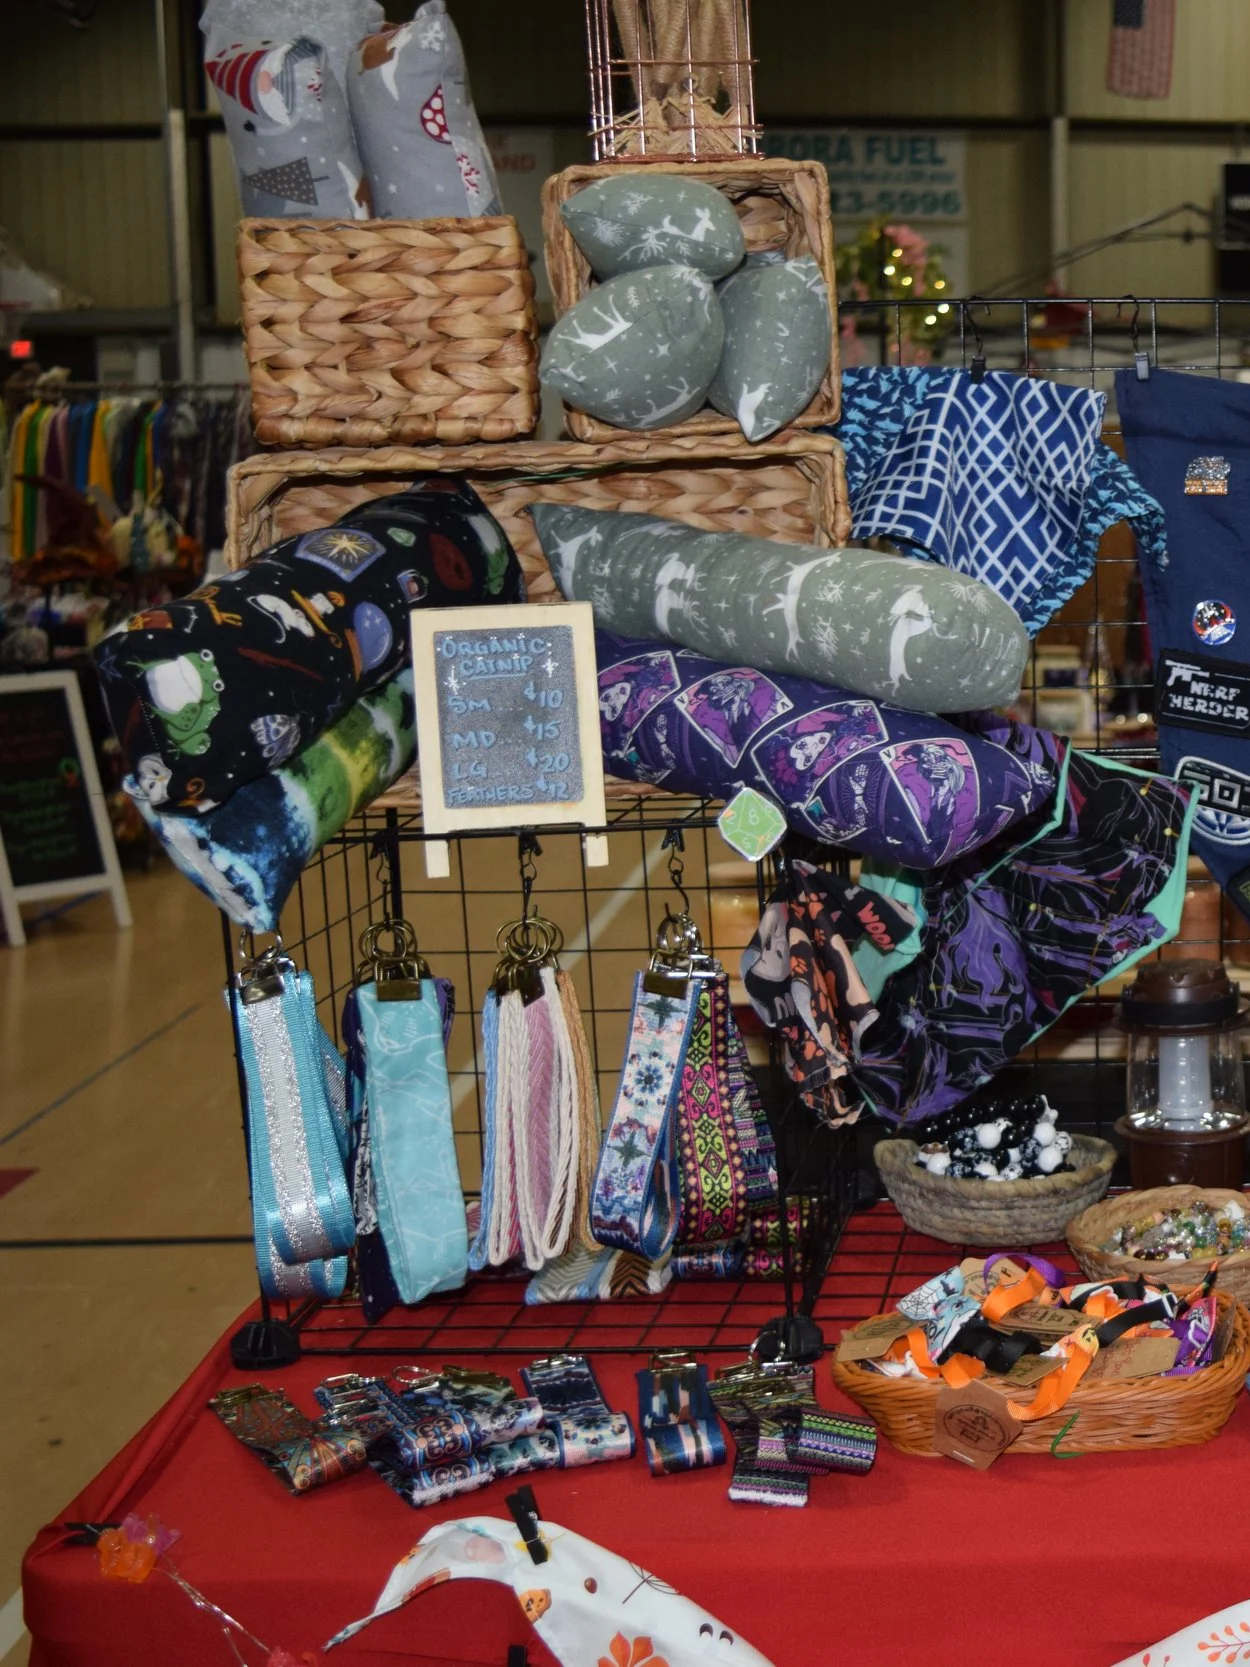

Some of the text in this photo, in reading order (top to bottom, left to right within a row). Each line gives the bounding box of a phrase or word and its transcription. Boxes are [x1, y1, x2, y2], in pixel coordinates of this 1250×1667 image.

[767, 134, 945, 165] RORA FUEL
[441, 637, 547, 658] ORGANIC
[459, 656, 533, 676] CATNIP
[1190, 680, 1241, 701] NERF
[1168, 693, 1250, 721] HERDER
[452, 730, 497, 750] MD
[525, 747, 571, 774] $20
[448, 784, 535, 804] FEATHERS
